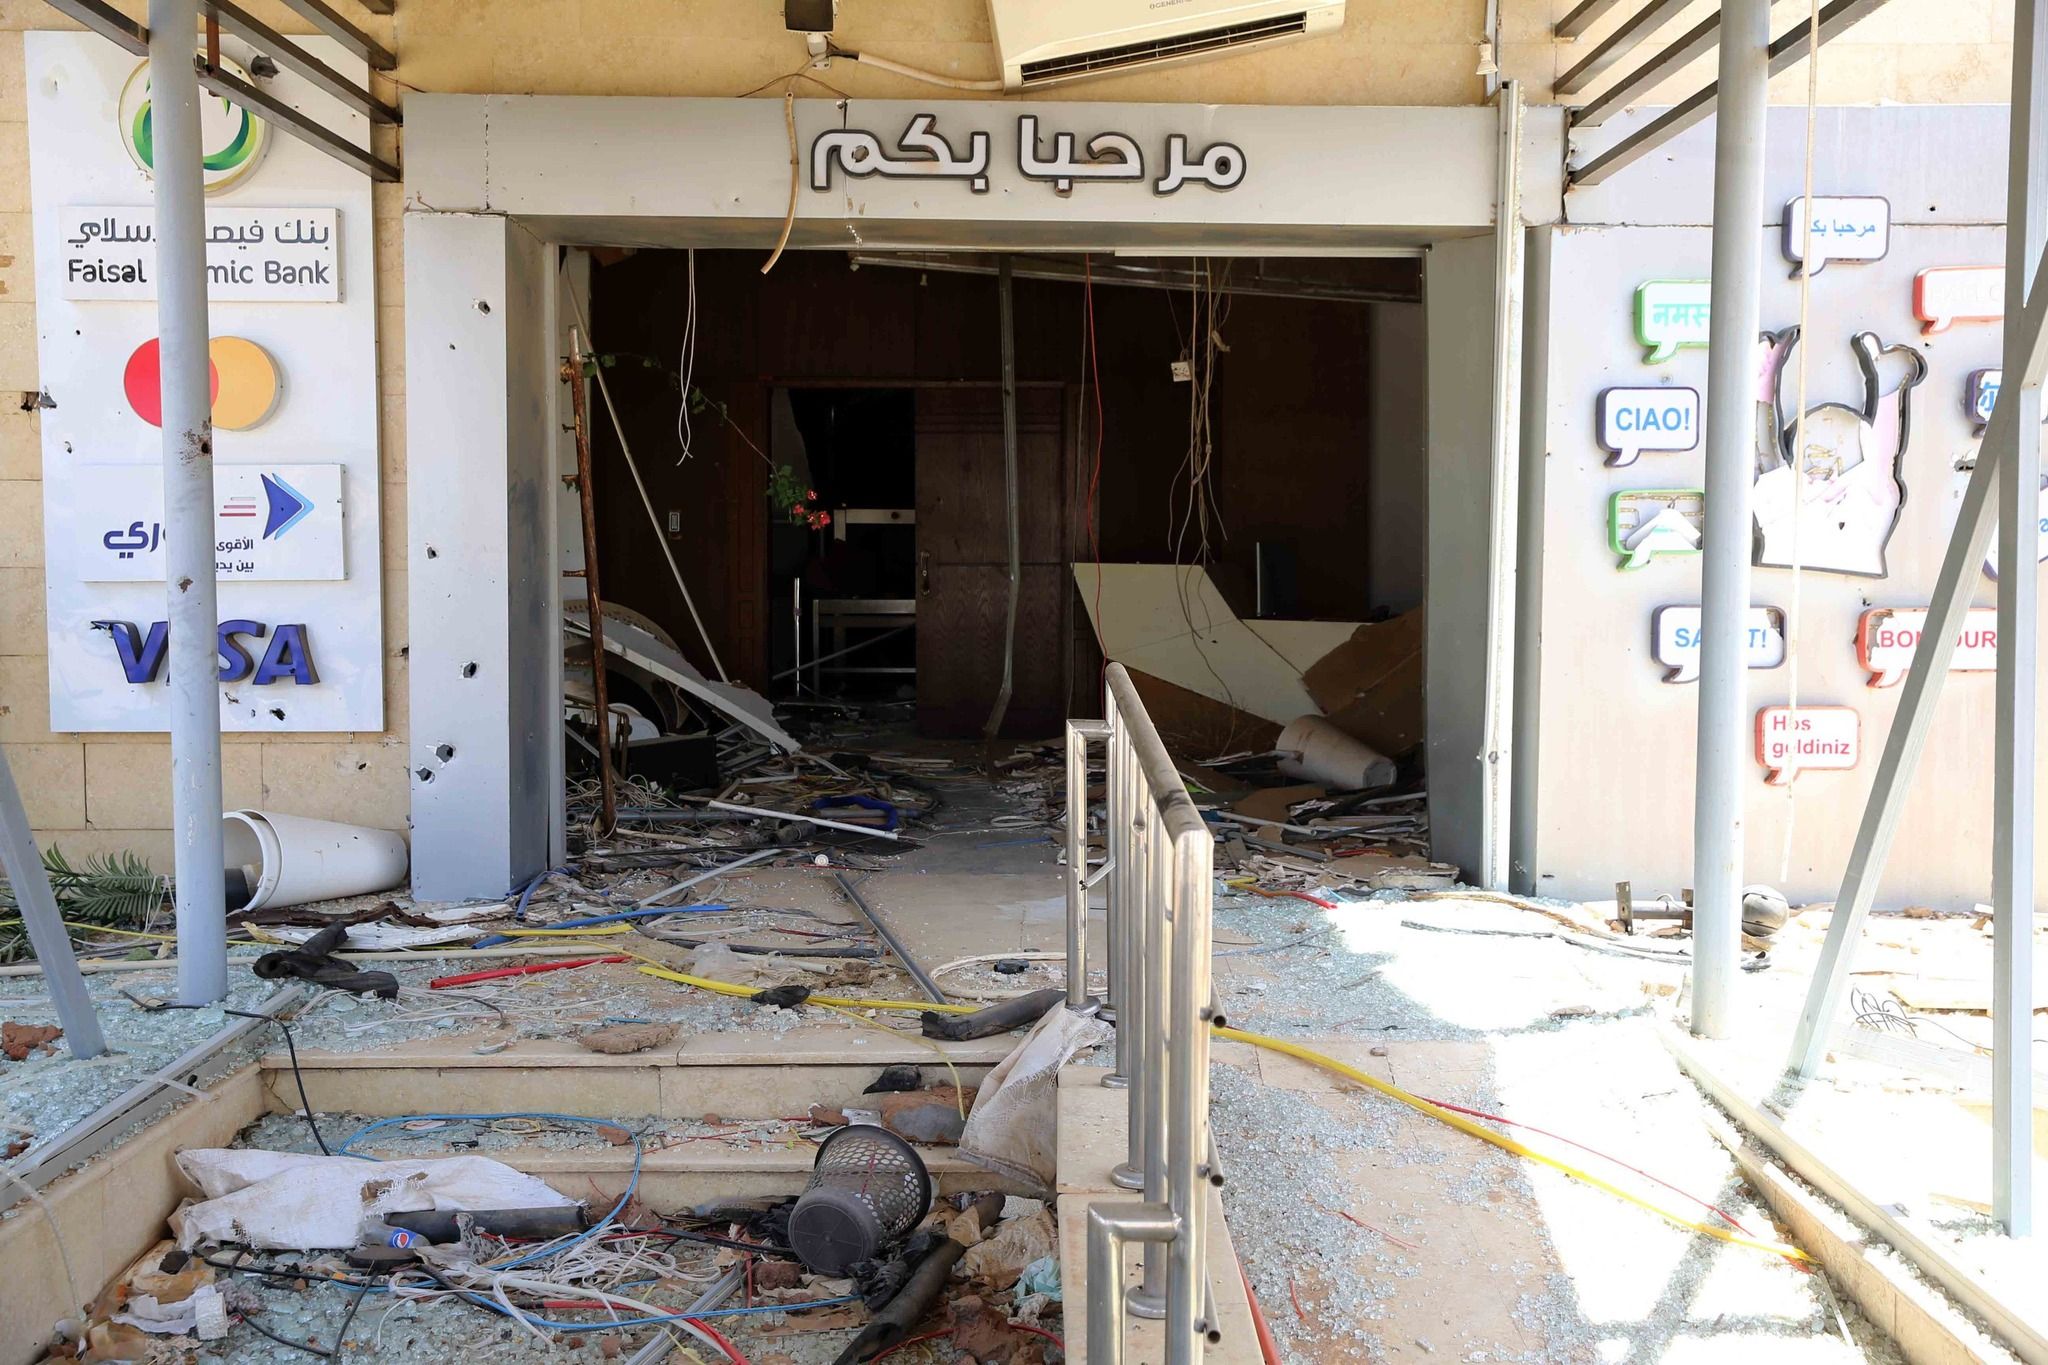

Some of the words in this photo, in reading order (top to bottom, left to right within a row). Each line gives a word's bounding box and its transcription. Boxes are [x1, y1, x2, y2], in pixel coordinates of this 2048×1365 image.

[810, 113, 991, 195] بكم
[1016, 113, 1247, 198] مرحبا
[67, 217, 157, 249] سلامي
[206, 219, 265, 250] فيص
[274, 219, 330, 250] بنك
[1810, 219, 1827, 237] بك
[1833, 219, 1876, 238] مرحبا
[67, 258, 147, 283] Faisal
[264, 259, 330, 284] Bank
[1615, 406, 1691, 433] CIAO!
[216, 536, 254, 553] الأقوى
[236, 559, 255, 573] بين
[1674, 627, 1766, 648] SAT!
[1880, 630, 1997, 649] BOUR
[91, 619, 320, 686] VSA
[1772, 738, 1851, 758] gldiniz
